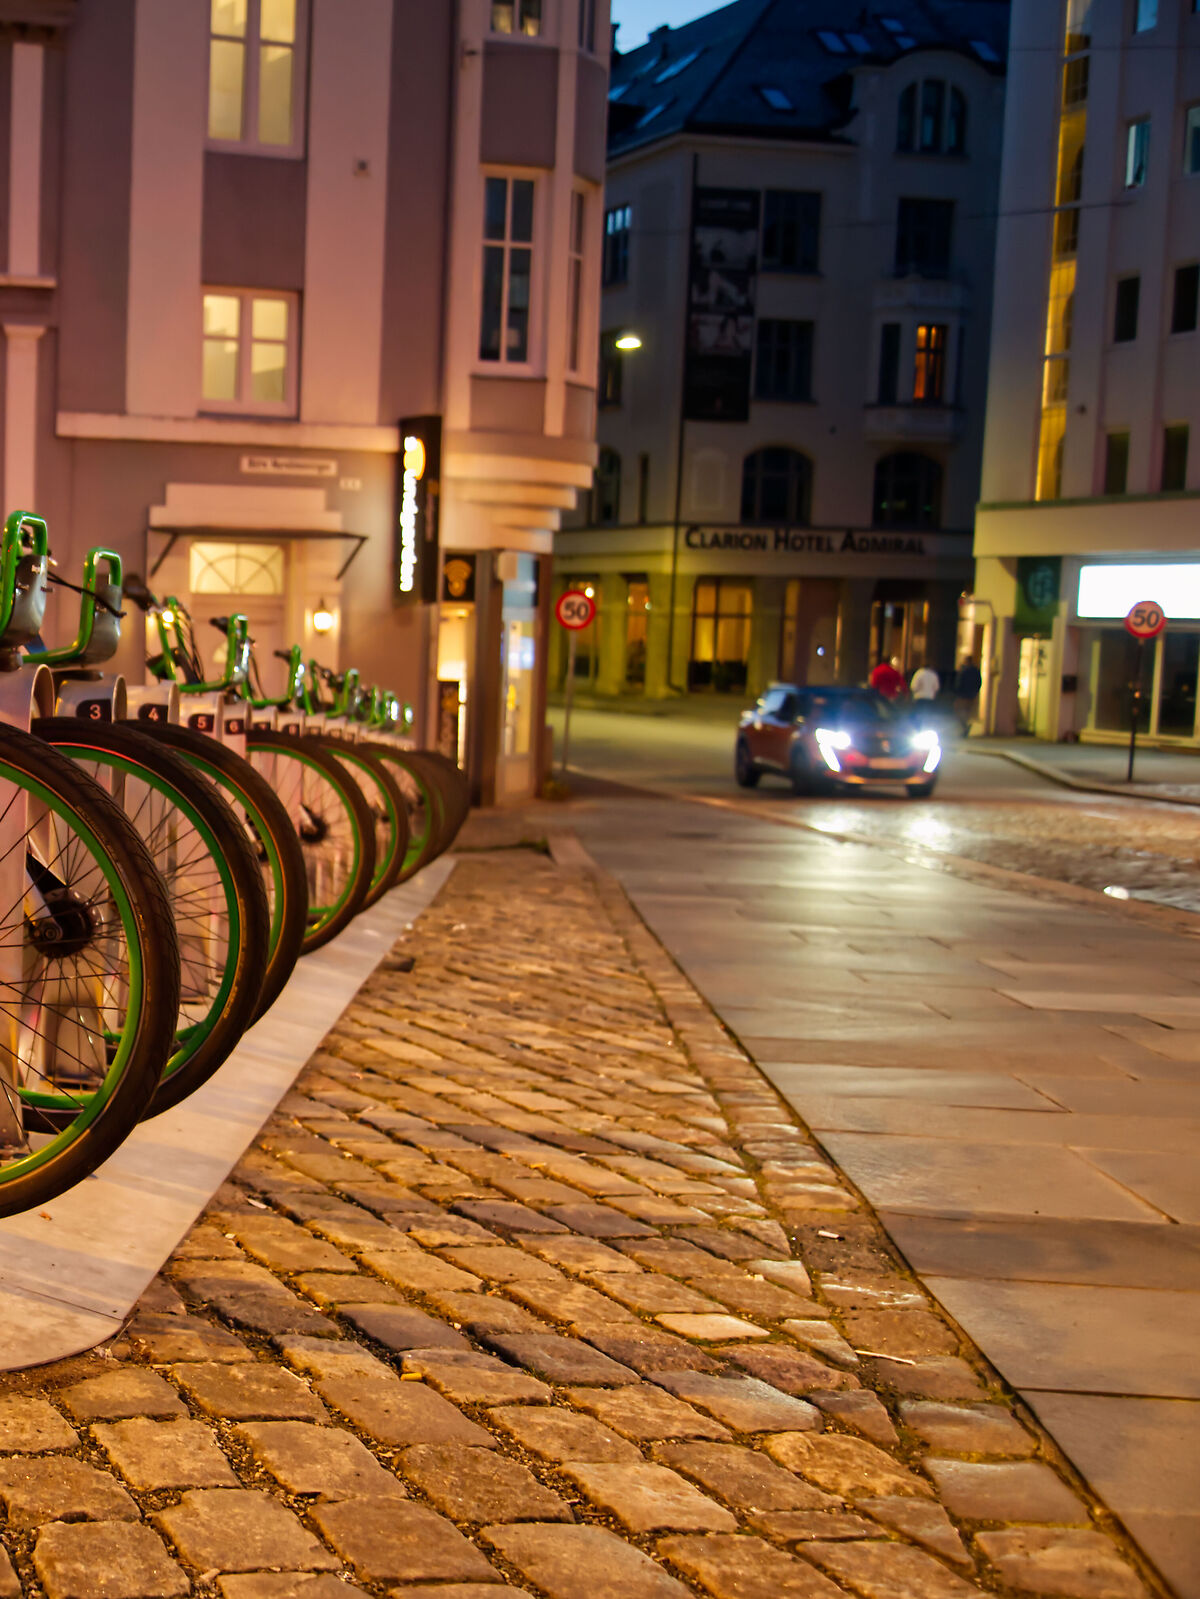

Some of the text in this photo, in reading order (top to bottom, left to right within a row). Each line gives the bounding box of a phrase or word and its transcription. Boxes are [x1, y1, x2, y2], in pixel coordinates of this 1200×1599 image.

[774, 528, 835, 552] HOTEL
[564, 601, 589, 621] 50
[1133, 609, 1160, 628] 50
[89, 704, 101, 720] 3
[148, 707, 159, 721] 4
[197, 716, 207, 729] 5
[229, 721, 239, 733] 6
